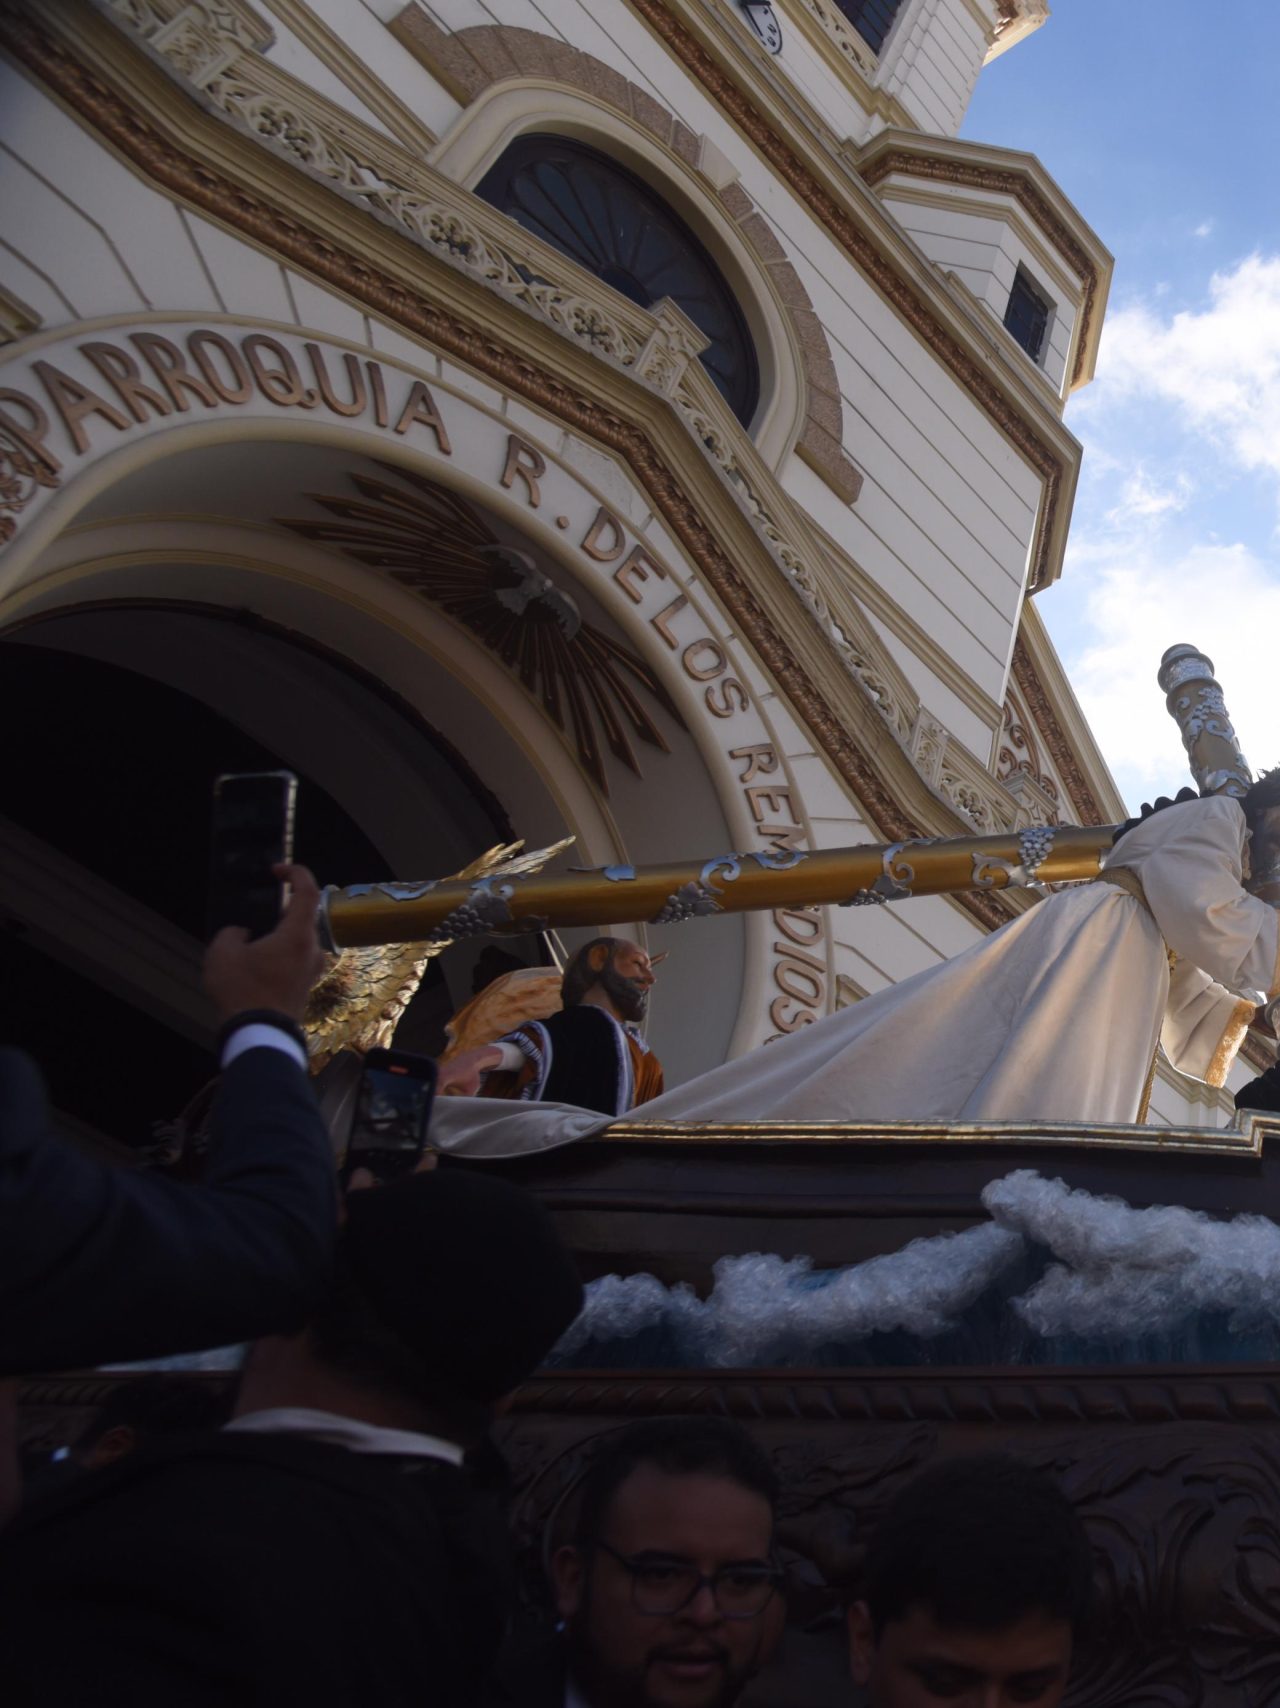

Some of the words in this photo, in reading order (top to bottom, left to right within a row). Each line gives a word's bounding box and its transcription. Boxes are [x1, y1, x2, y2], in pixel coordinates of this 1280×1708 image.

[0, 329, 451, 474] PARROQUIA
[581, 505, 667, 604] DE
[651, 593, 751, 719] LOS
[728, 743, 827, 1034] REMDIOS
